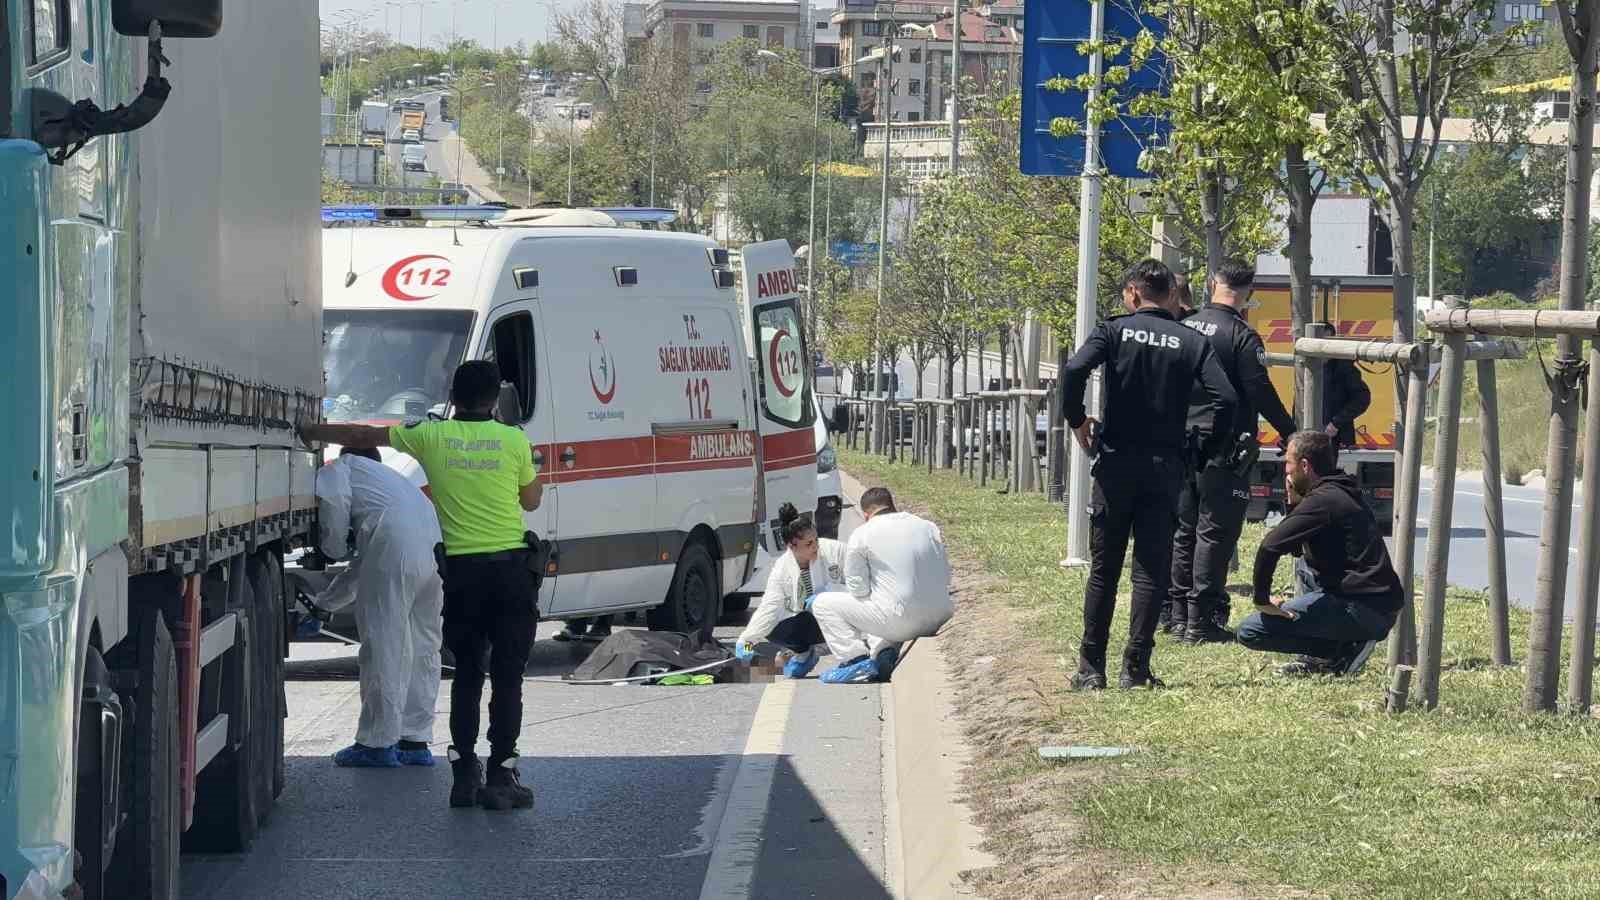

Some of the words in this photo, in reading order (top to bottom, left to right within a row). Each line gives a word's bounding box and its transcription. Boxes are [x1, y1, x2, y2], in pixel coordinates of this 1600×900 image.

[401, 267, 451, 287] 112
[777, 350, 798, 377] 112
[685, 377, 713, 420] 112
[690, 432, 753, 460] AMBULANS
